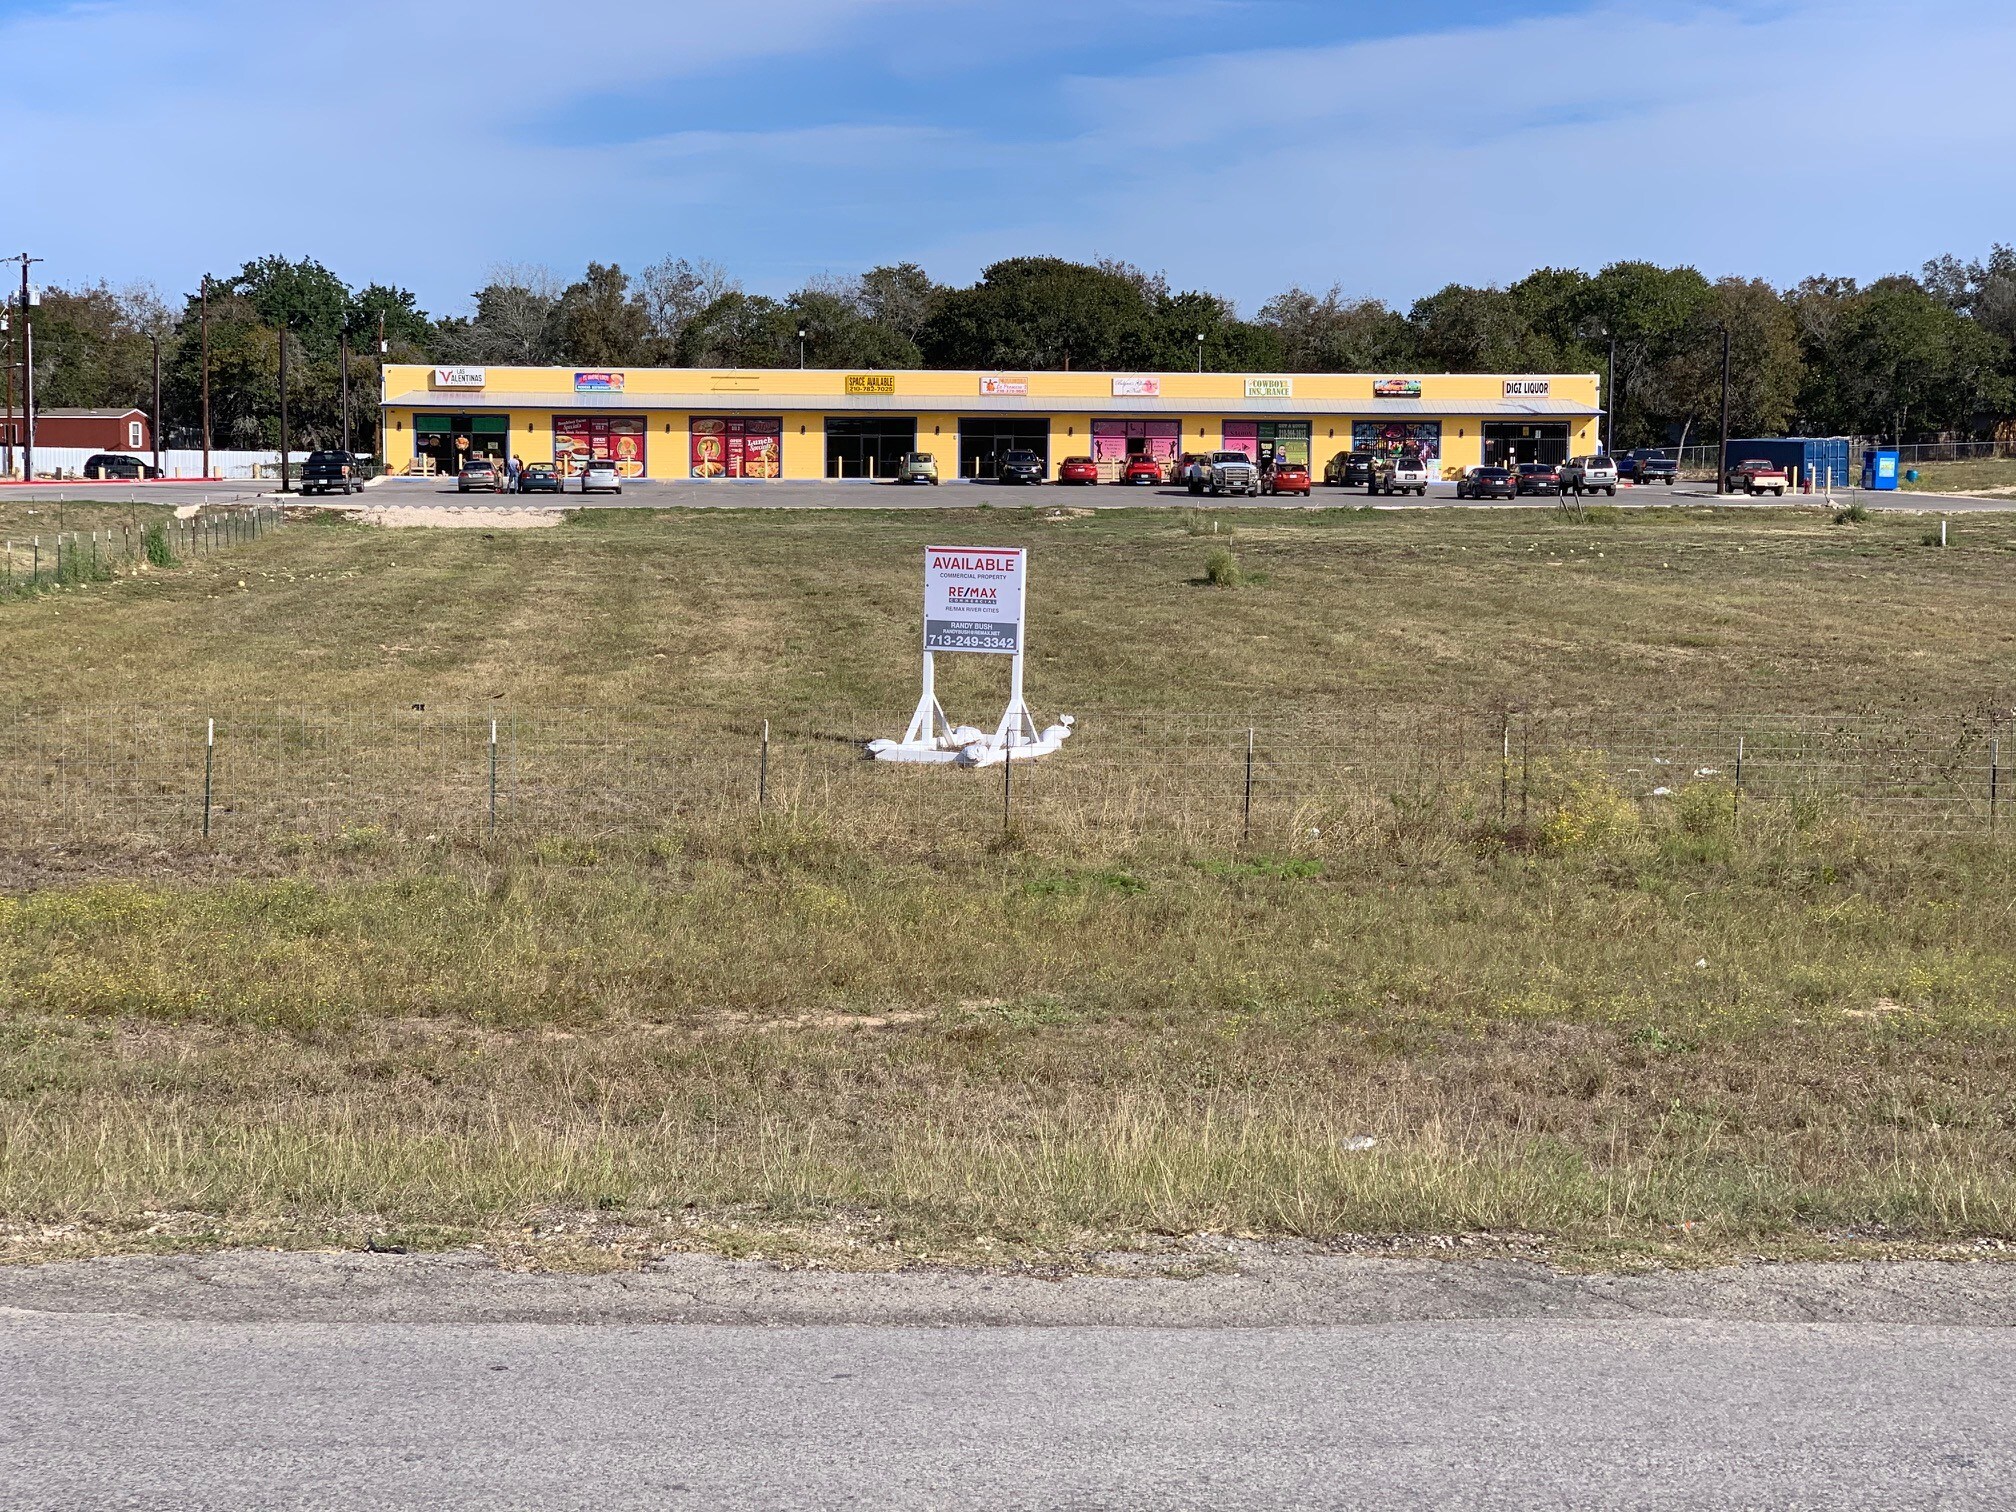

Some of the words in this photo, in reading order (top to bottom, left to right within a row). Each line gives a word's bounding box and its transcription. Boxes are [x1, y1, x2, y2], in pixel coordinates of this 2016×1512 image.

[439, 370, 482, 384] VALENTINAS
[850, 377, 865, 386] SPACE
[867, 378, 892, 386] AVAILABLE
[1506, 383, 1522, 393] DIGZ
[1524, 383, 1548, 394] LIQUOR
[748, 437, 773, 446] Lunch
[932, 557, 1014, 571] AVAILABLE
[949, 587, 996, 598] RE/MAX
[929, 635, 1014, 648] 713-249-3342
